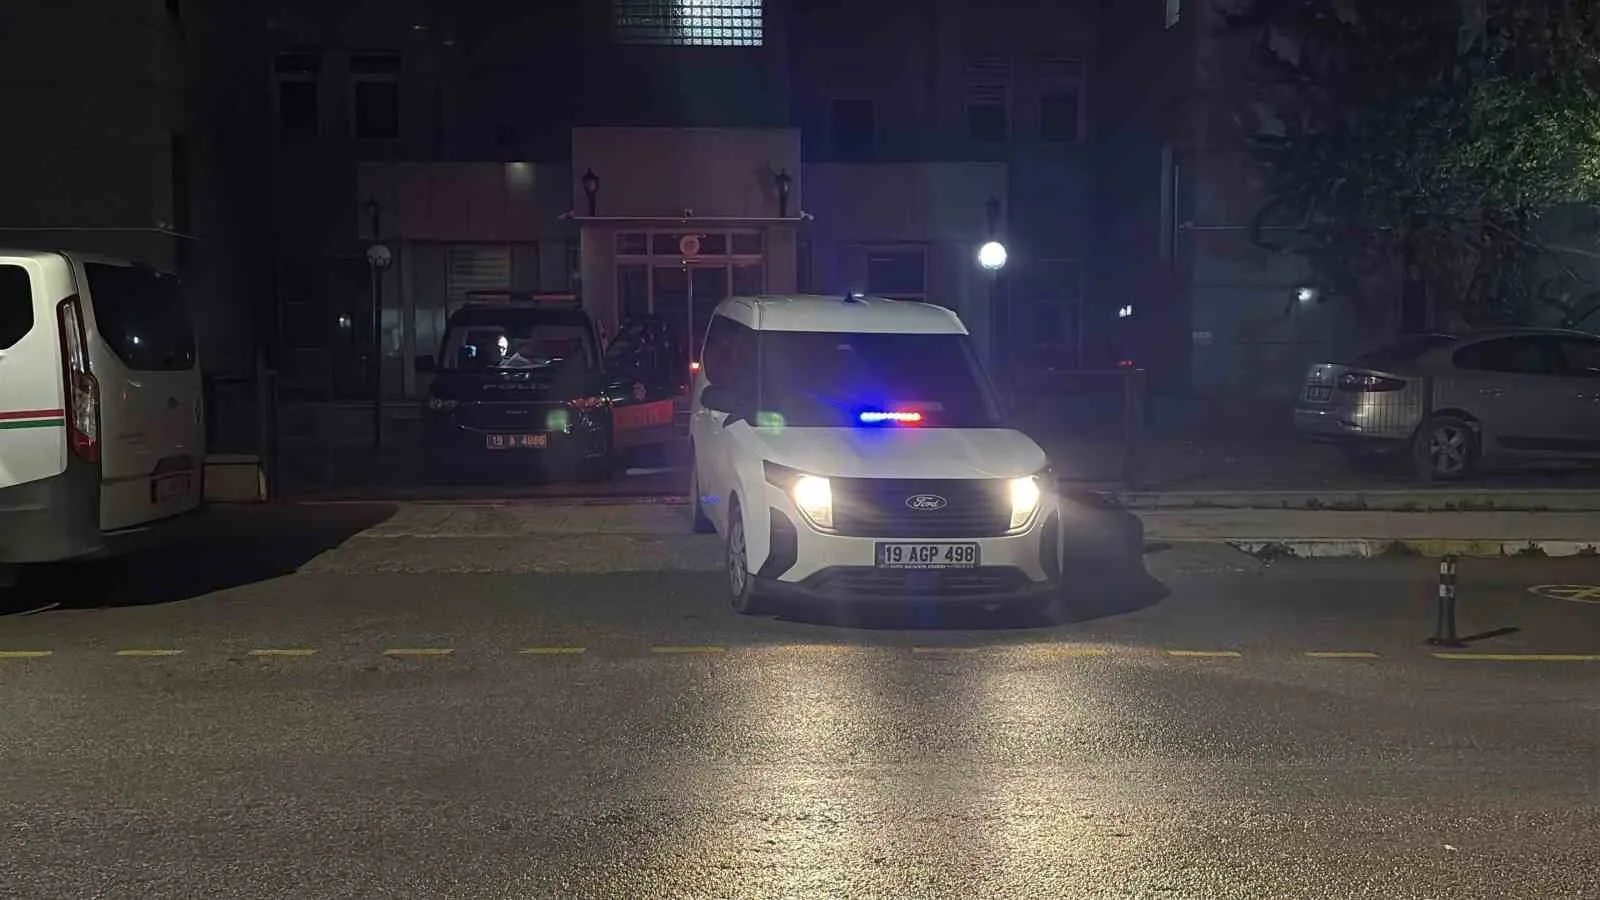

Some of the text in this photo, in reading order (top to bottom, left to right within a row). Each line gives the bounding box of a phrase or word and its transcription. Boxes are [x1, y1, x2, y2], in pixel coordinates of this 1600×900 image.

[886, 546, 975, 562] 19 AGP 498
